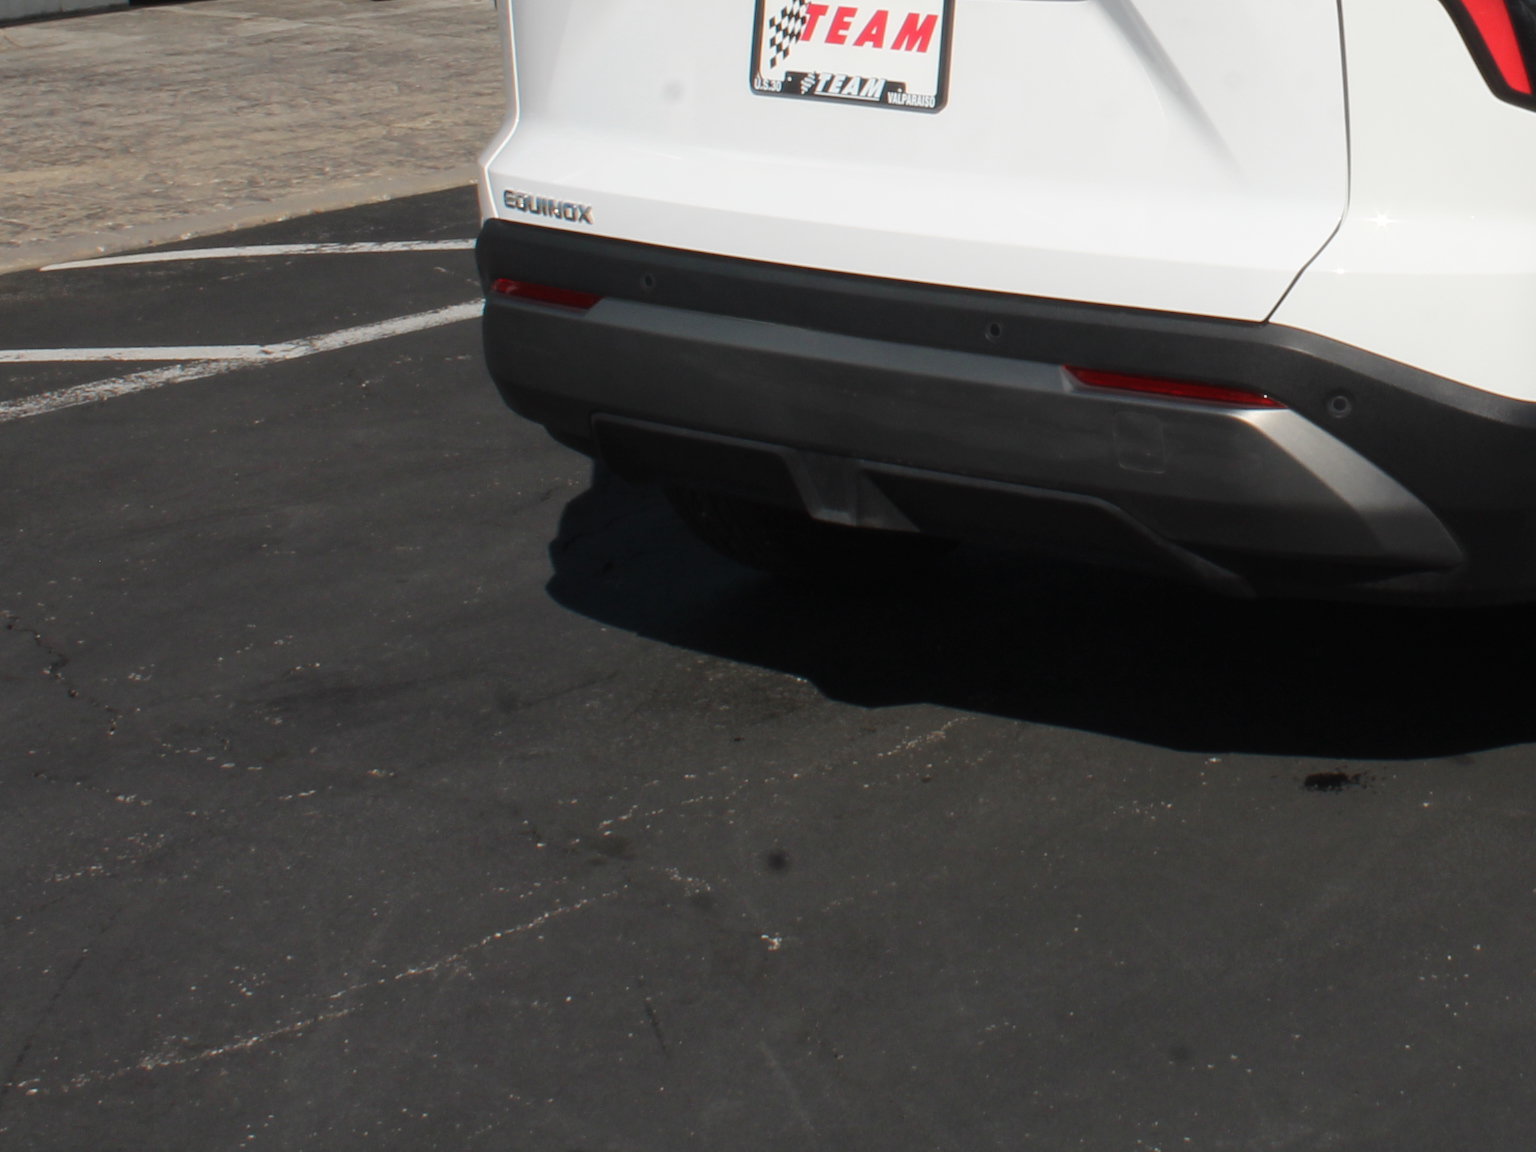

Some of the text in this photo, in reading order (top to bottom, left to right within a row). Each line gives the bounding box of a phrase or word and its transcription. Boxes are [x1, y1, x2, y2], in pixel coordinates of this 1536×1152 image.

[800, 3, 939, 53] TEAM
[814, 72, 887, 98] TEAM
[887, 91, 936, 108] VALPARAISO
[503, 189, 593, 225] EQUINOX
